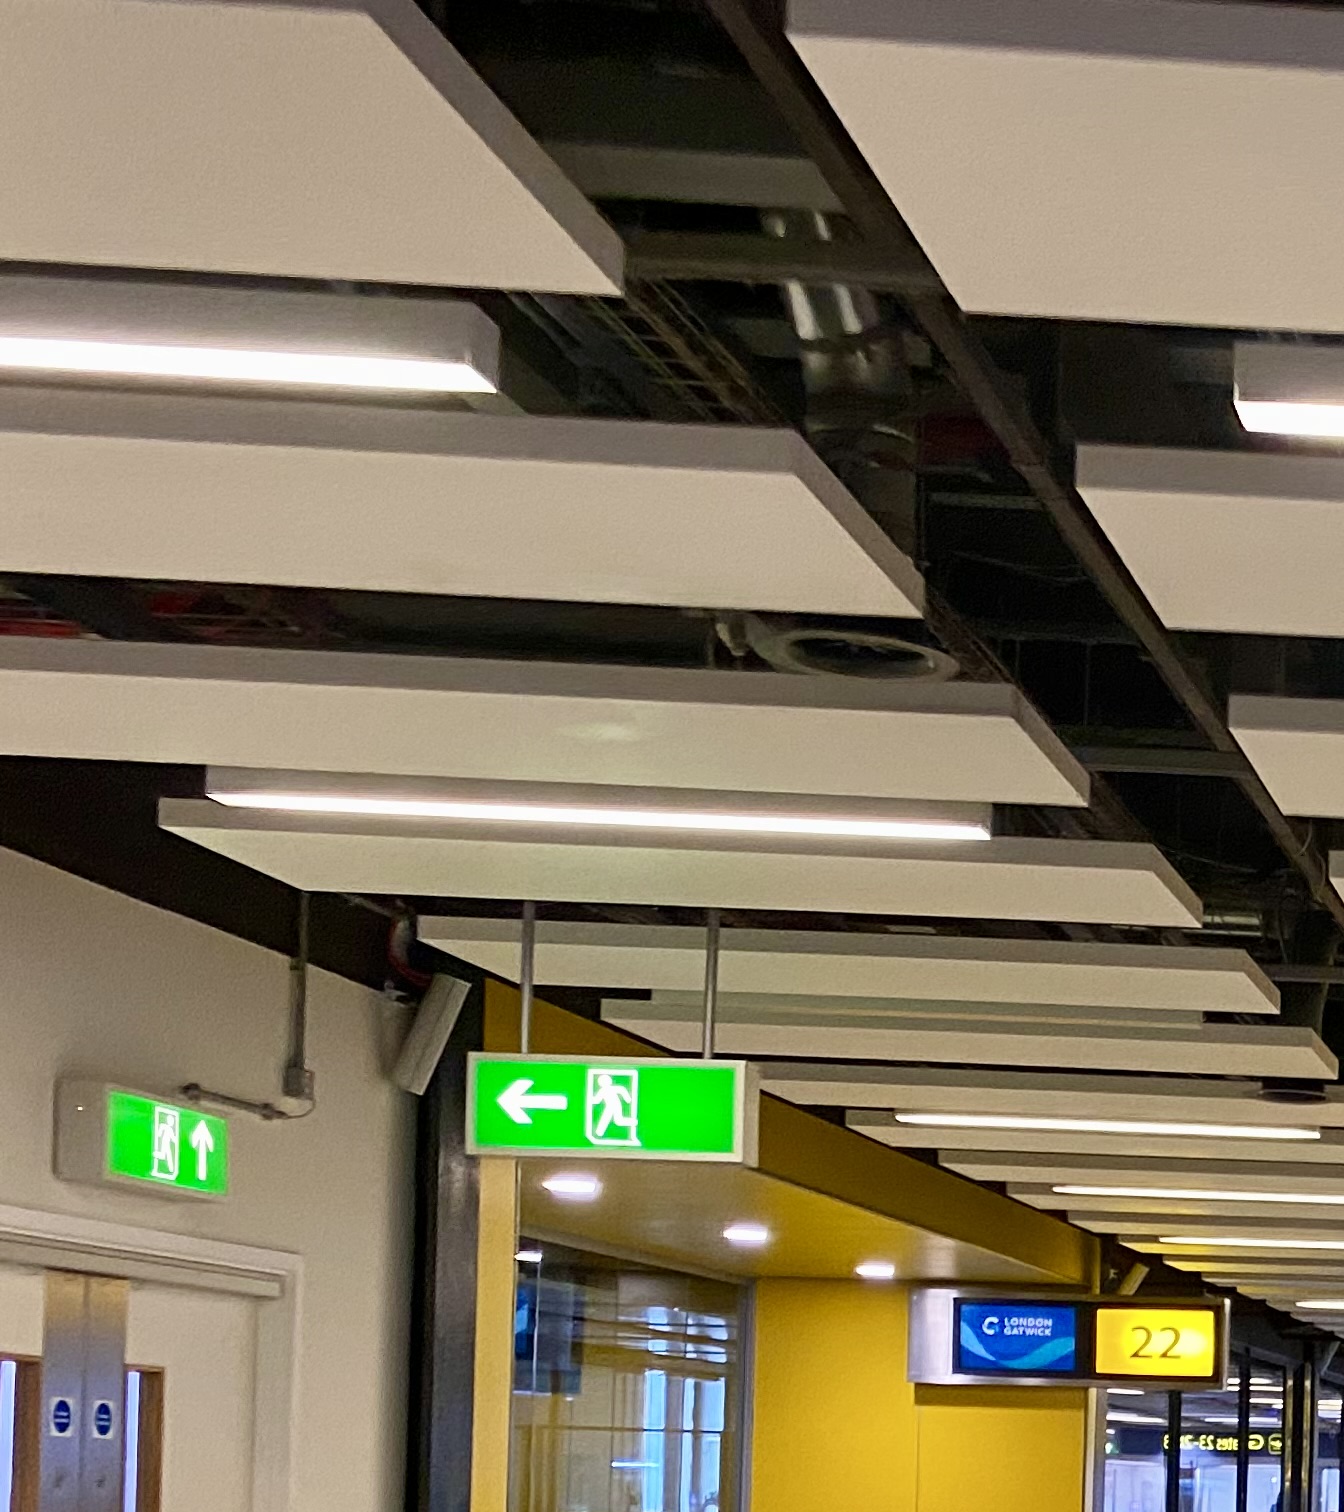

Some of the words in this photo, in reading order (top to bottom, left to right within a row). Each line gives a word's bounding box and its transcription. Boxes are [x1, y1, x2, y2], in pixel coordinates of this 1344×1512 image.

[1004, 1317, 1053, 1327] LONDON
[1004, 1327, 1052, 1336] GATWICK
[1130, 1326, 1181, 1359] 22
